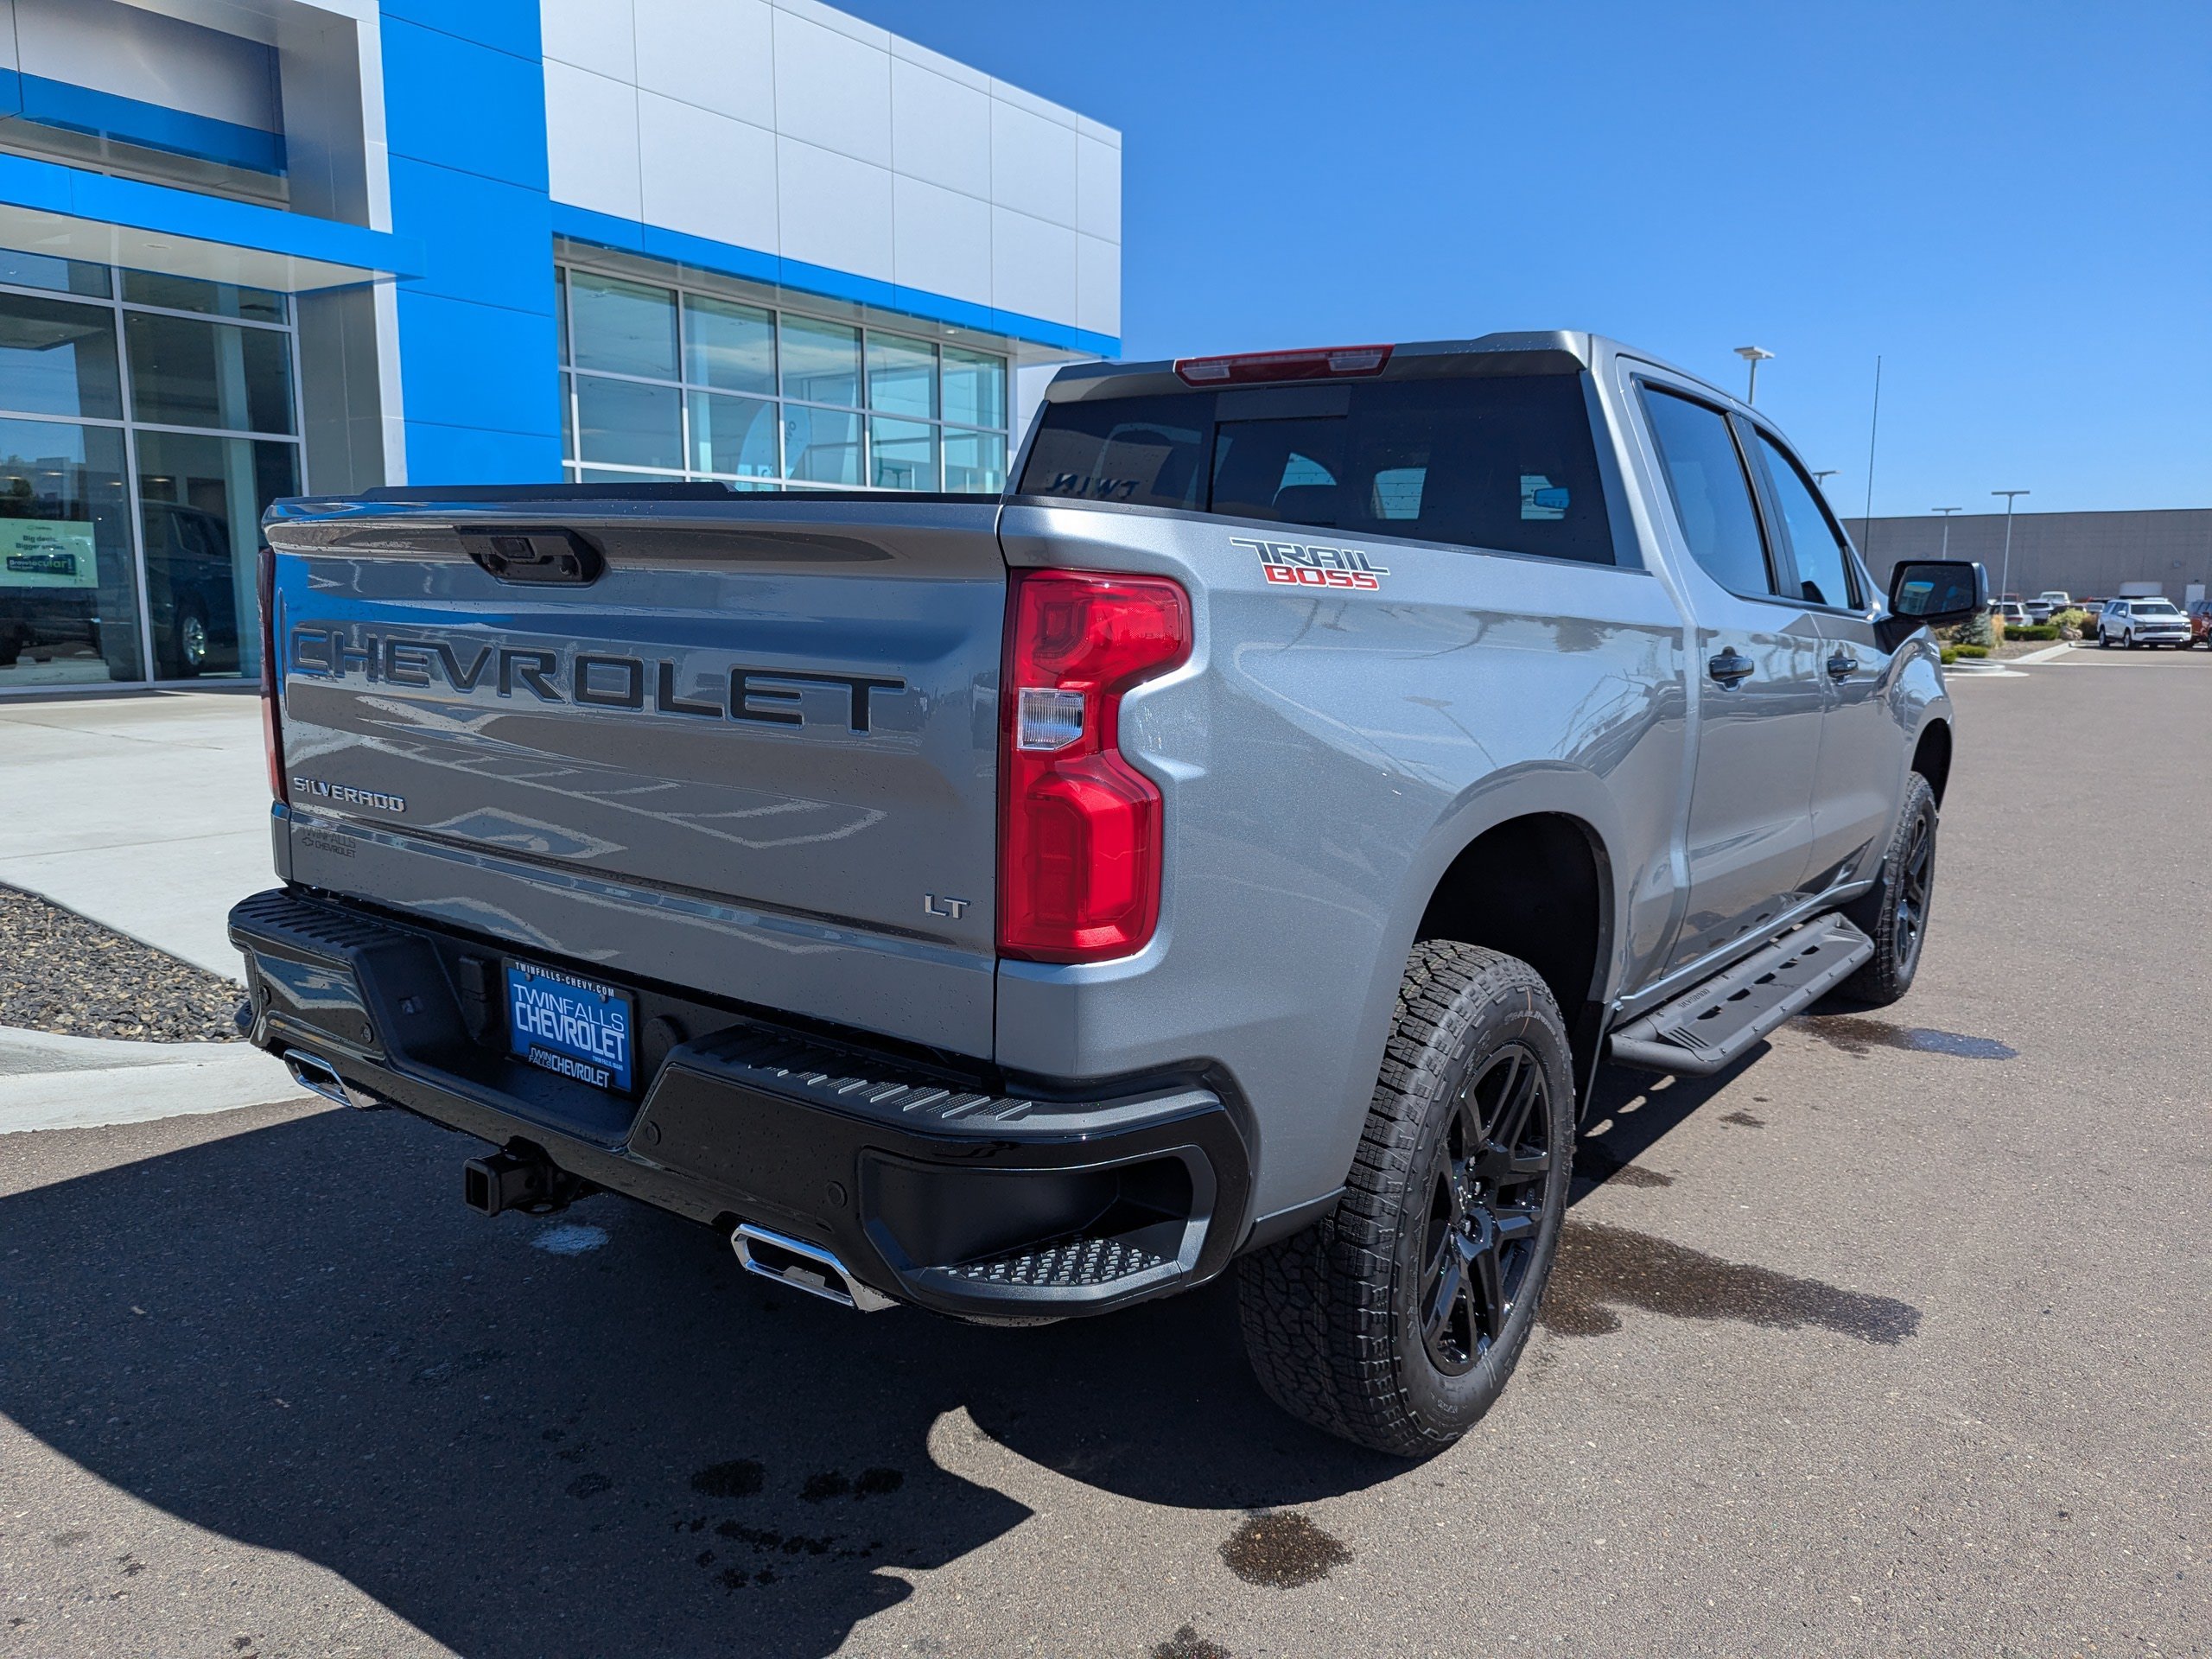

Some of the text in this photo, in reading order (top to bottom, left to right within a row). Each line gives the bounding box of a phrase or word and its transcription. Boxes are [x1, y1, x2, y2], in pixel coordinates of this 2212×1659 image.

[23, 535, 35, 543] Big
[1230, 537, 1390, 575] TRAIL
[1263, 563, 1379, 591] BOSS
[290, 627, 907, 736] CHEVROLET
[293, 777, 406, 812] SILVERADO
[315, 841, 356, 858] CHEVROLET
[925, 893, 970, 919] LT
[515, 962, 614, 997] TWINFALLS-CHEVY.COM
[513, 984, 624, 1032] TWINFALLS
[515, 1001, 625, 1062] CHEVROLET
[528, 1055, 552, 1069] FALLS
[531, 1047, 552, 1061] TWIN
[551, 1054, 610, 1089] CHEVROLET
